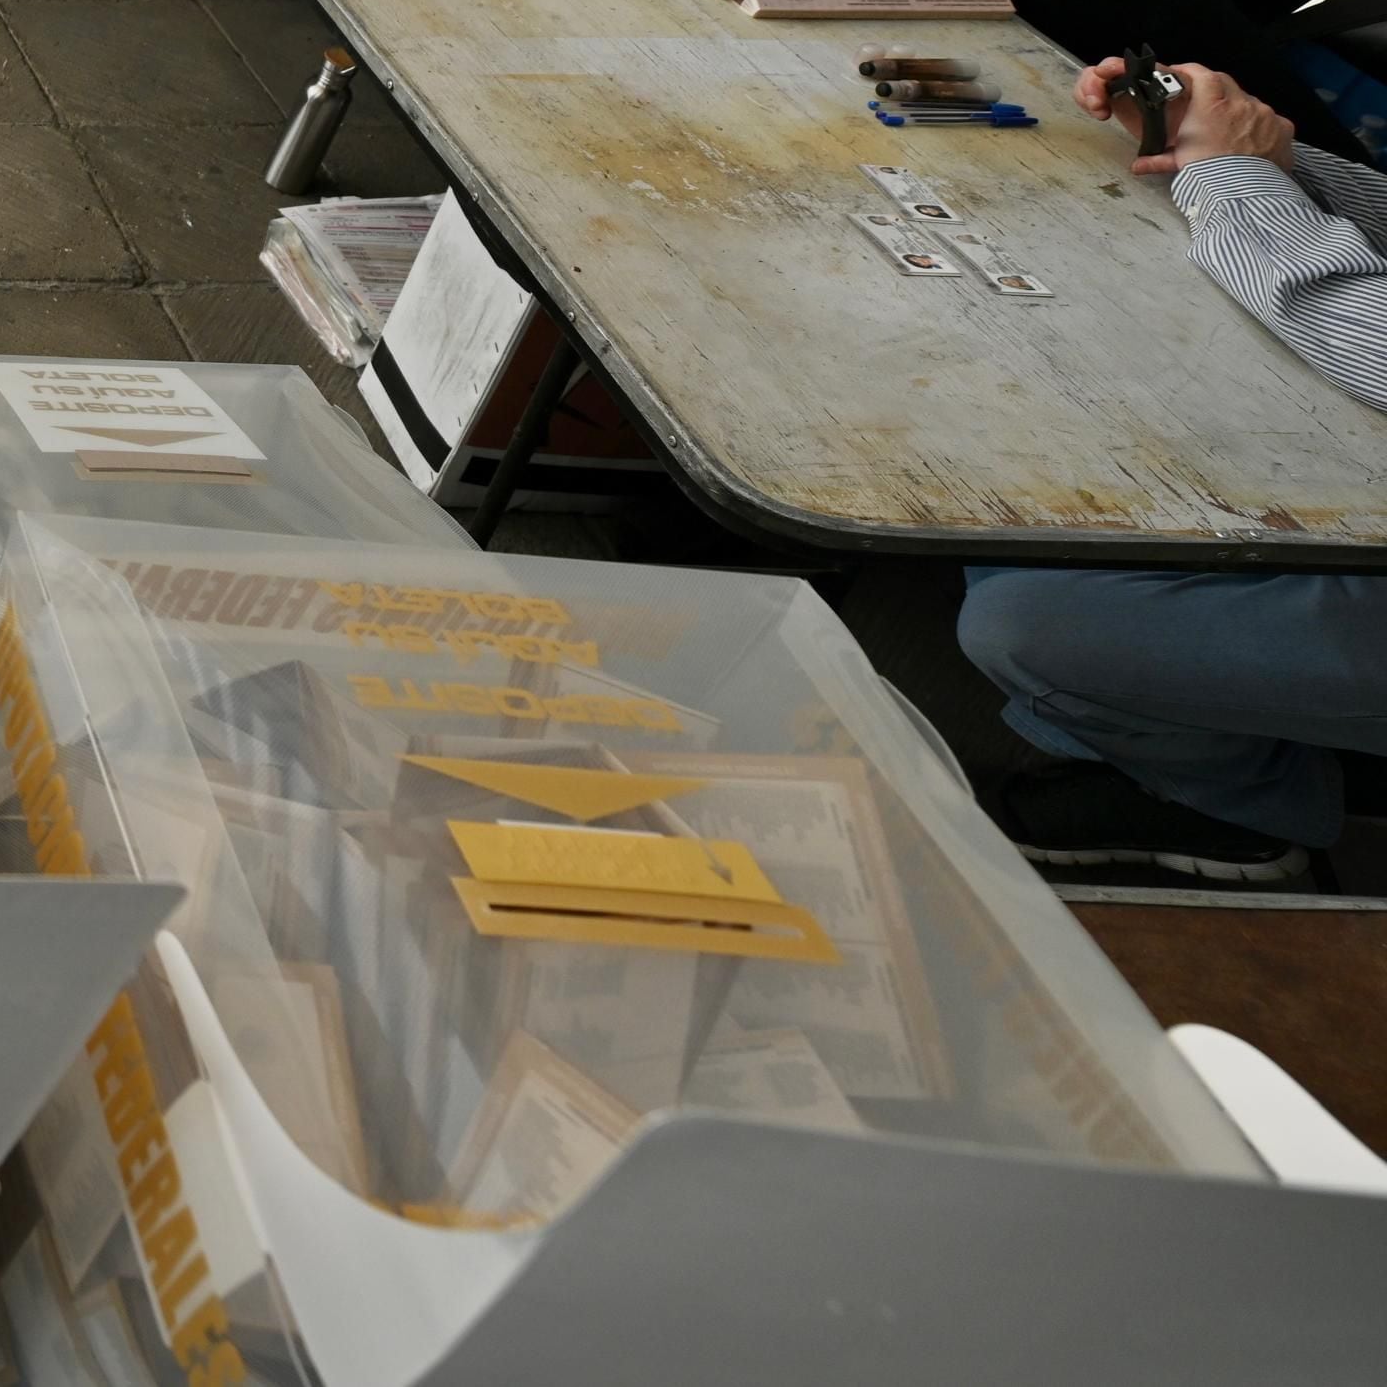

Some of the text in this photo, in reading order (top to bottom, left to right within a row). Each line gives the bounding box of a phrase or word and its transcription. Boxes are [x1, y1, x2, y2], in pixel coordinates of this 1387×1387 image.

[20, 368, 163, 384] BOLETA
[32, 384, 176, 401] AQUÍ SU
[27, 400, 215, 418] DEPOSITE
[343, 619, 437, 655] SU
[347, 674, 684, 734] DEPOSITE
